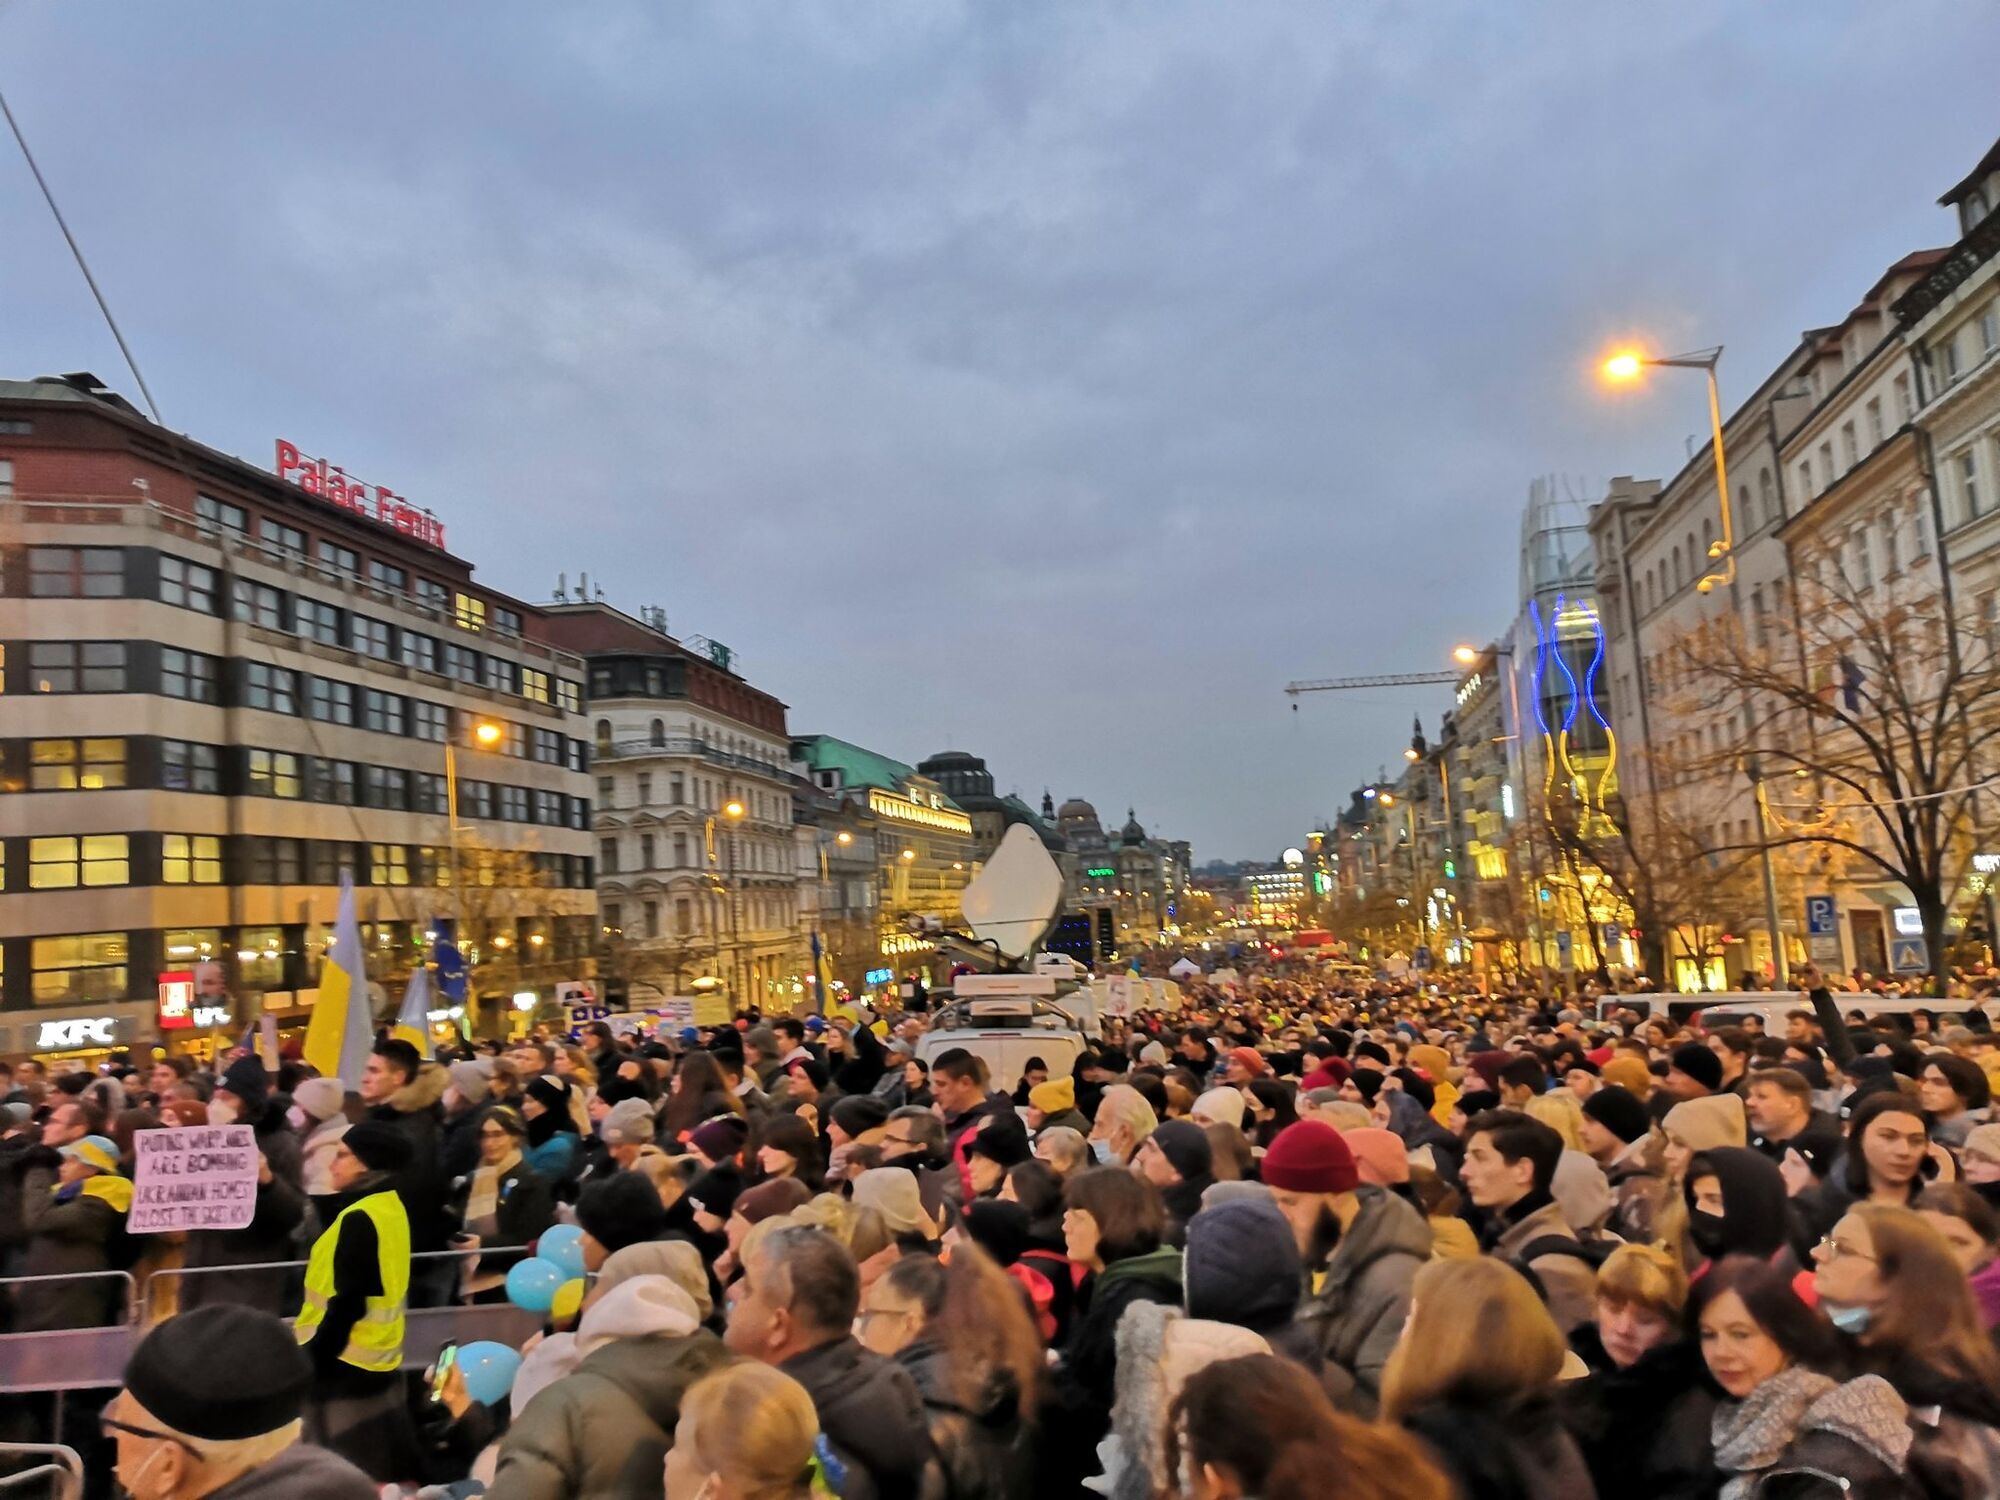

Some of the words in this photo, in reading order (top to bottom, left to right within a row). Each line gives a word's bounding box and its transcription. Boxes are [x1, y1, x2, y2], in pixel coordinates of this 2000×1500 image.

[275, 438, 365, 517] Palác
[1811, 900, 1830, 922] P
[36, 1017, 118, 1048] KFC
[150, 1155, 181, 1175] ARE
